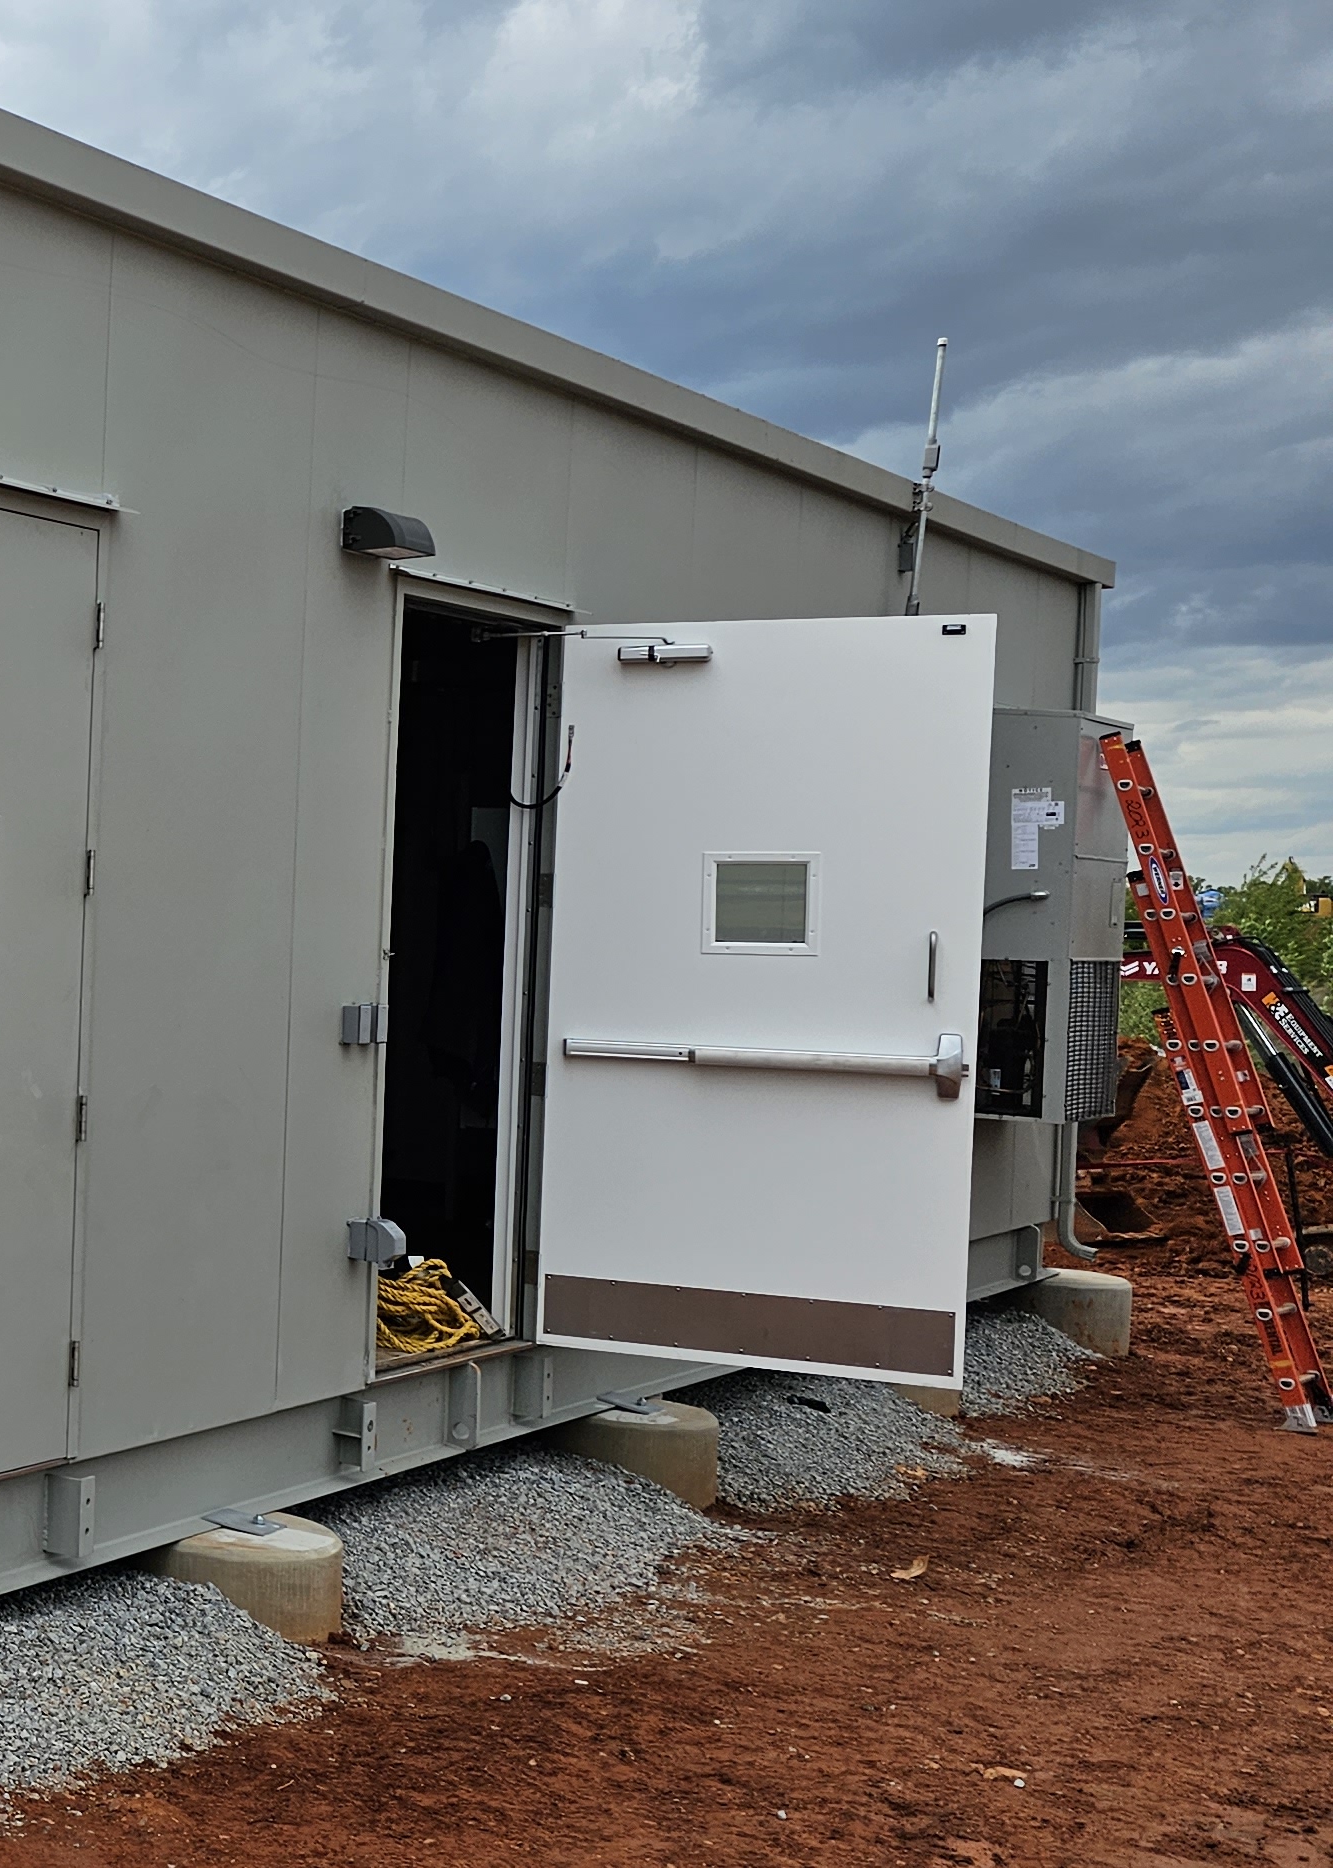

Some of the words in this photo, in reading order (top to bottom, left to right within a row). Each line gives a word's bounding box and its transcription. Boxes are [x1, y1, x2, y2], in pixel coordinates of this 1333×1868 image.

[1152, 865, 1166, 896] WERNER
[1278, 1018, 1310, 1055] SERVICES
[1285, 1012, 1324, 1058] EQUIPMENT
